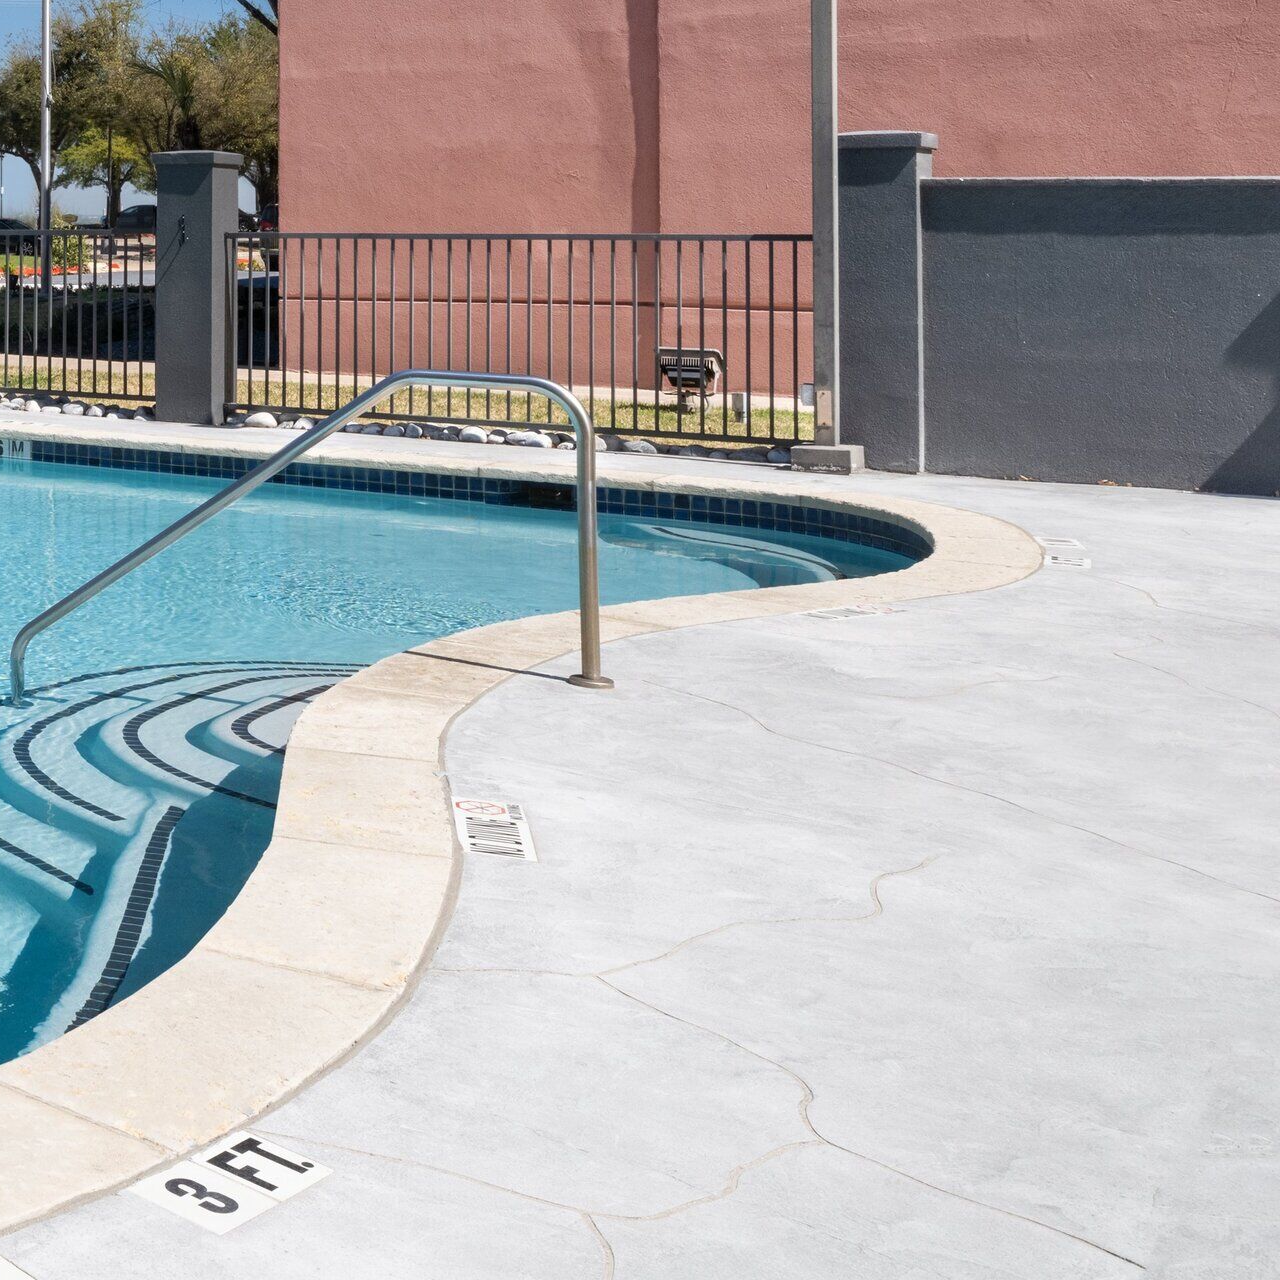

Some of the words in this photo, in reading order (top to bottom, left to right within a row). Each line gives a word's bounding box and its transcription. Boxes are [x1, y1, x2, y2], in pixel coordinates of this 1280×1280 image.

[11, 440, 24, 454] M
[165, 1177, 240, 1214] 3
[206, 1137, 315, 1191] FT.
